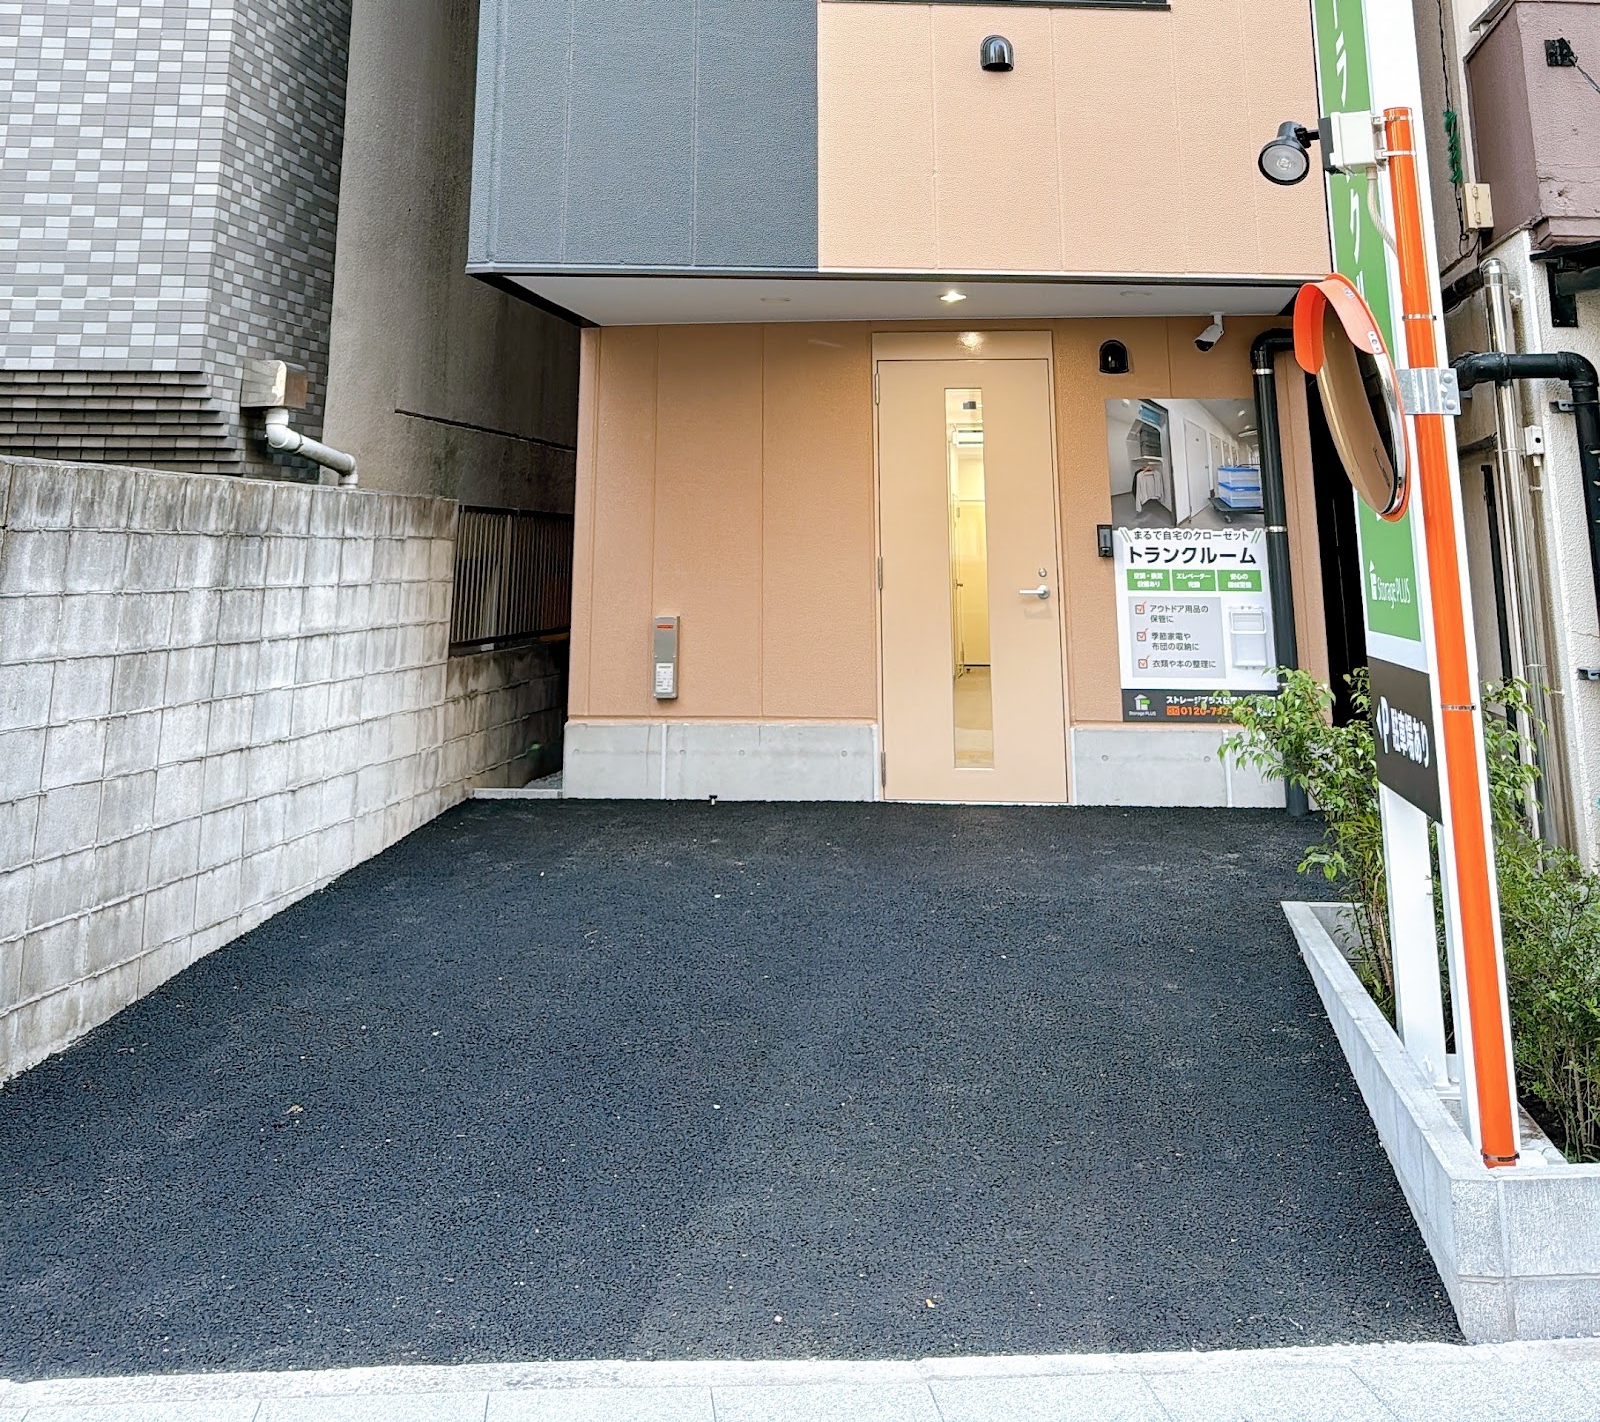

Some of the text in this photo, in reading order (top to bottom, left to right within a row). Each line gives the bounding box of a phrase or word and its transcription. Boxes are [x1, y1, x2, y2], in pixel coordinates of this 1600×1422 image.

[1133, 530, 1249, 541] まるで自宅のクローゼット
[1129, 546, 1257, 564] トランクルーム
[1149, 604, 1209, 614] アウトドア用品の
[1152, 642, 1200, 651] 布団の収納に
[1153, 660, 1217, 669] 衣類や本の整理に
[1390, 707, 1430, 769] 駐車場あり
